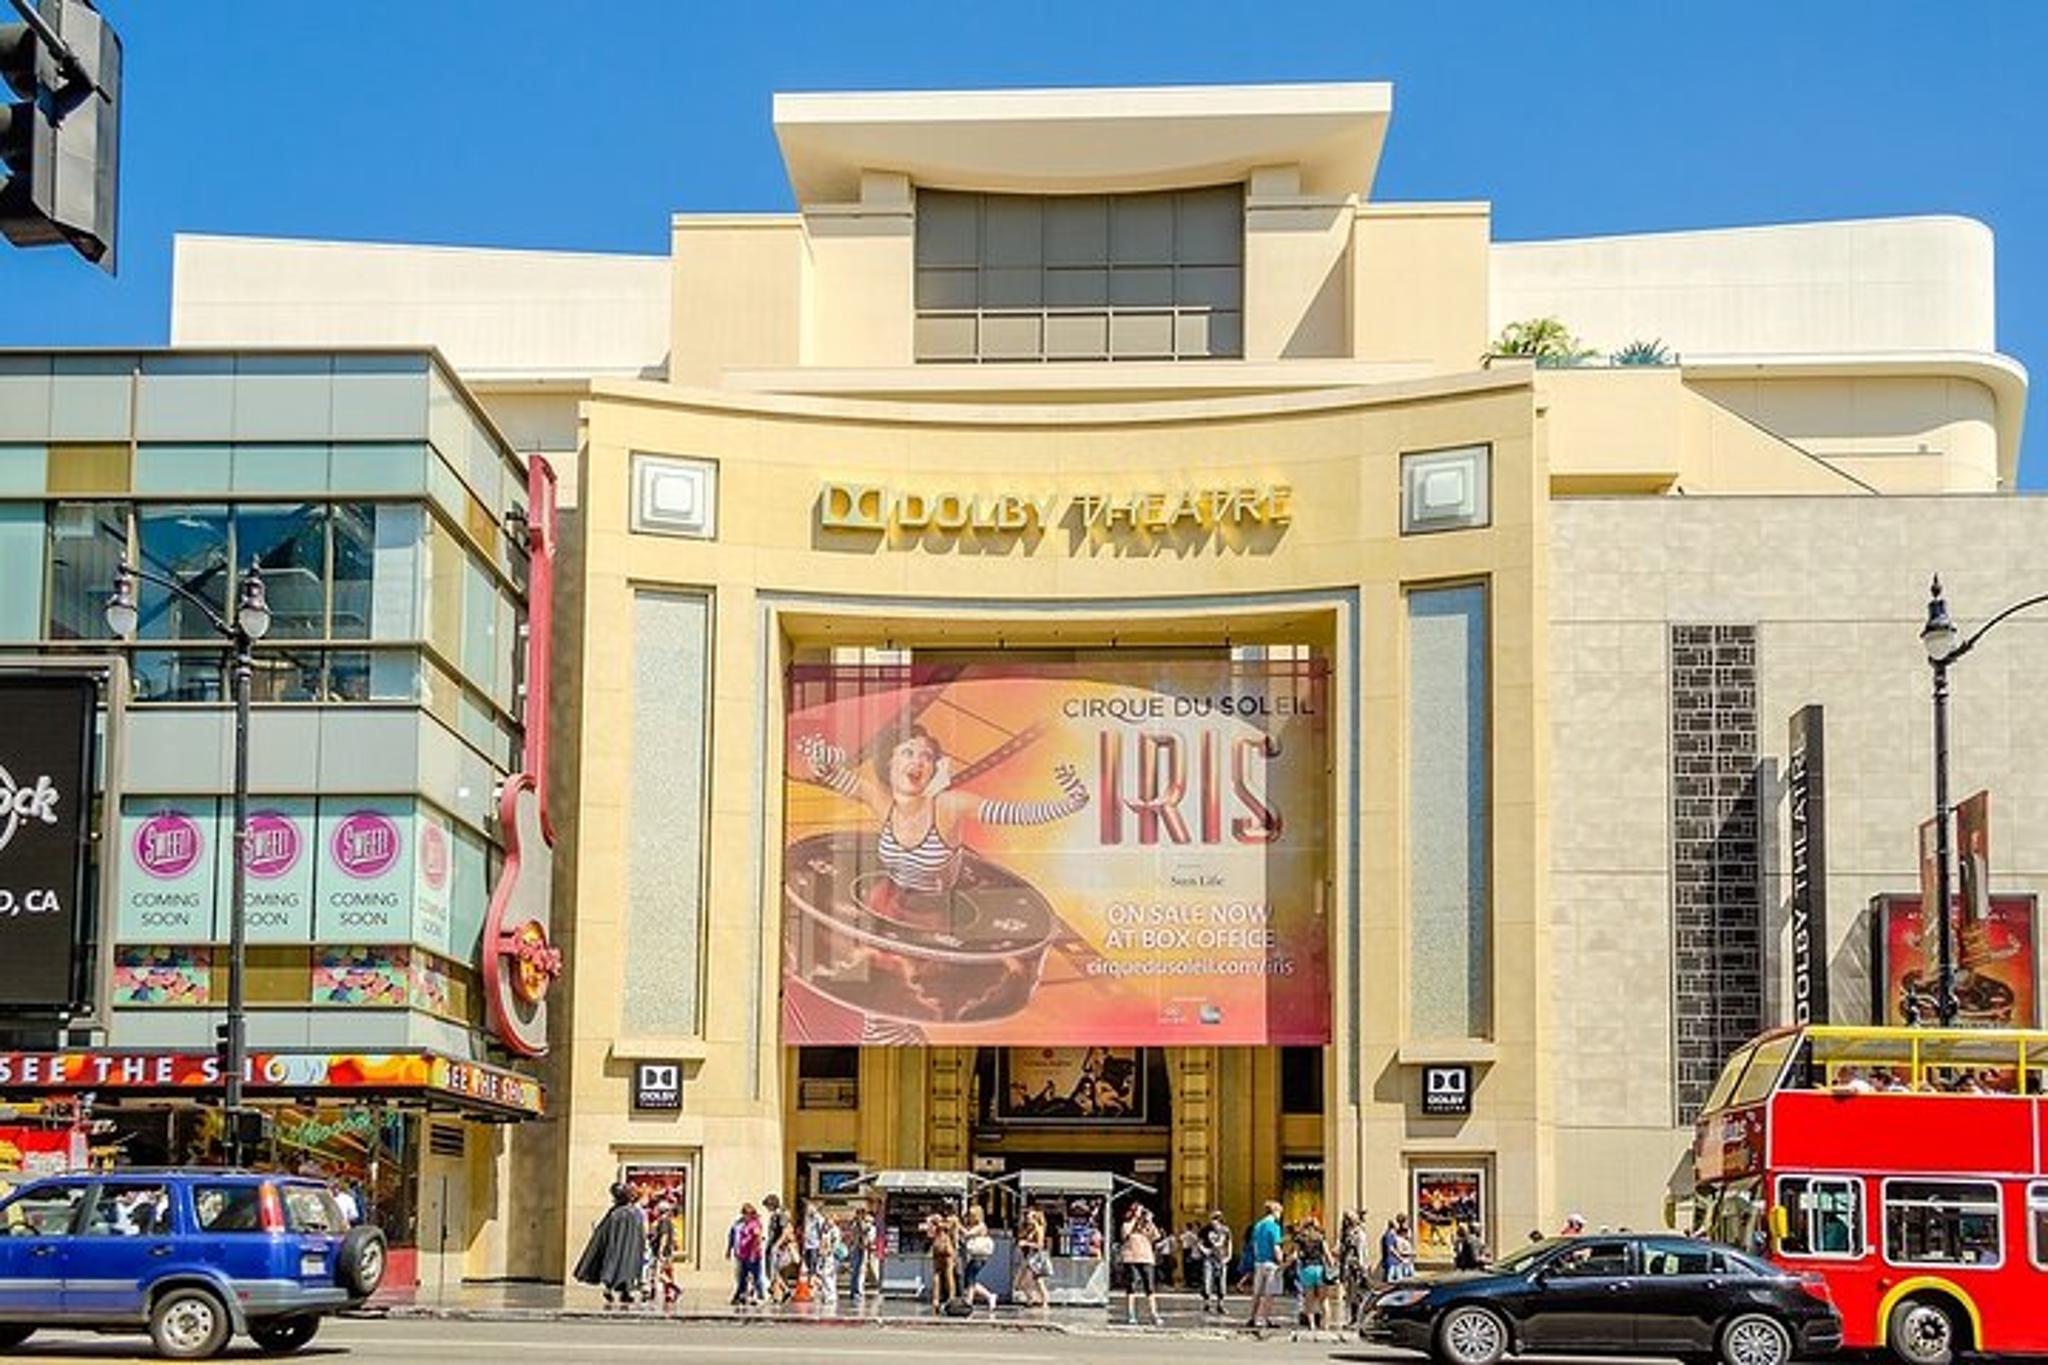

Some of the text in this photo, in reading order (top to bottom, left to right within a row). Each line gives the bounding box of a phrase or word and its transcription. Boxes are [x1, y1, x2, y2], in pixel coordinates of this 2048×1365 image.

[899, 486, 1292, 530] DOLBY THEATRE
[1063, 696, 1316, 724] CIRQUE DU SOLEIL
[1100, 729, 1284, 846] IRIS
[0, 775, 60, 823] ock
[25, 889, 61, 912] CA
[132, 892, 200, 908] COMING
[244, 892, 299, 908] OMING
[330, 892, 399, 908] COMING
[141, 911, 189, 926] SOON
[340, 910, 388, 927] SOON
[1108, 902, 1275, 924] ON SALE NOW
[1106, 928, 1276, 948] AT BOX OFFICE
[1793, 908, 1812, 1024] DOLBY
[0, 1056, 66, 1083] SEE
[95, 1056, 175, 1083] THE
[640, 1091, 678, 1102] DOLBY
[1427, 1094, 1465, 1104] DOLBY
